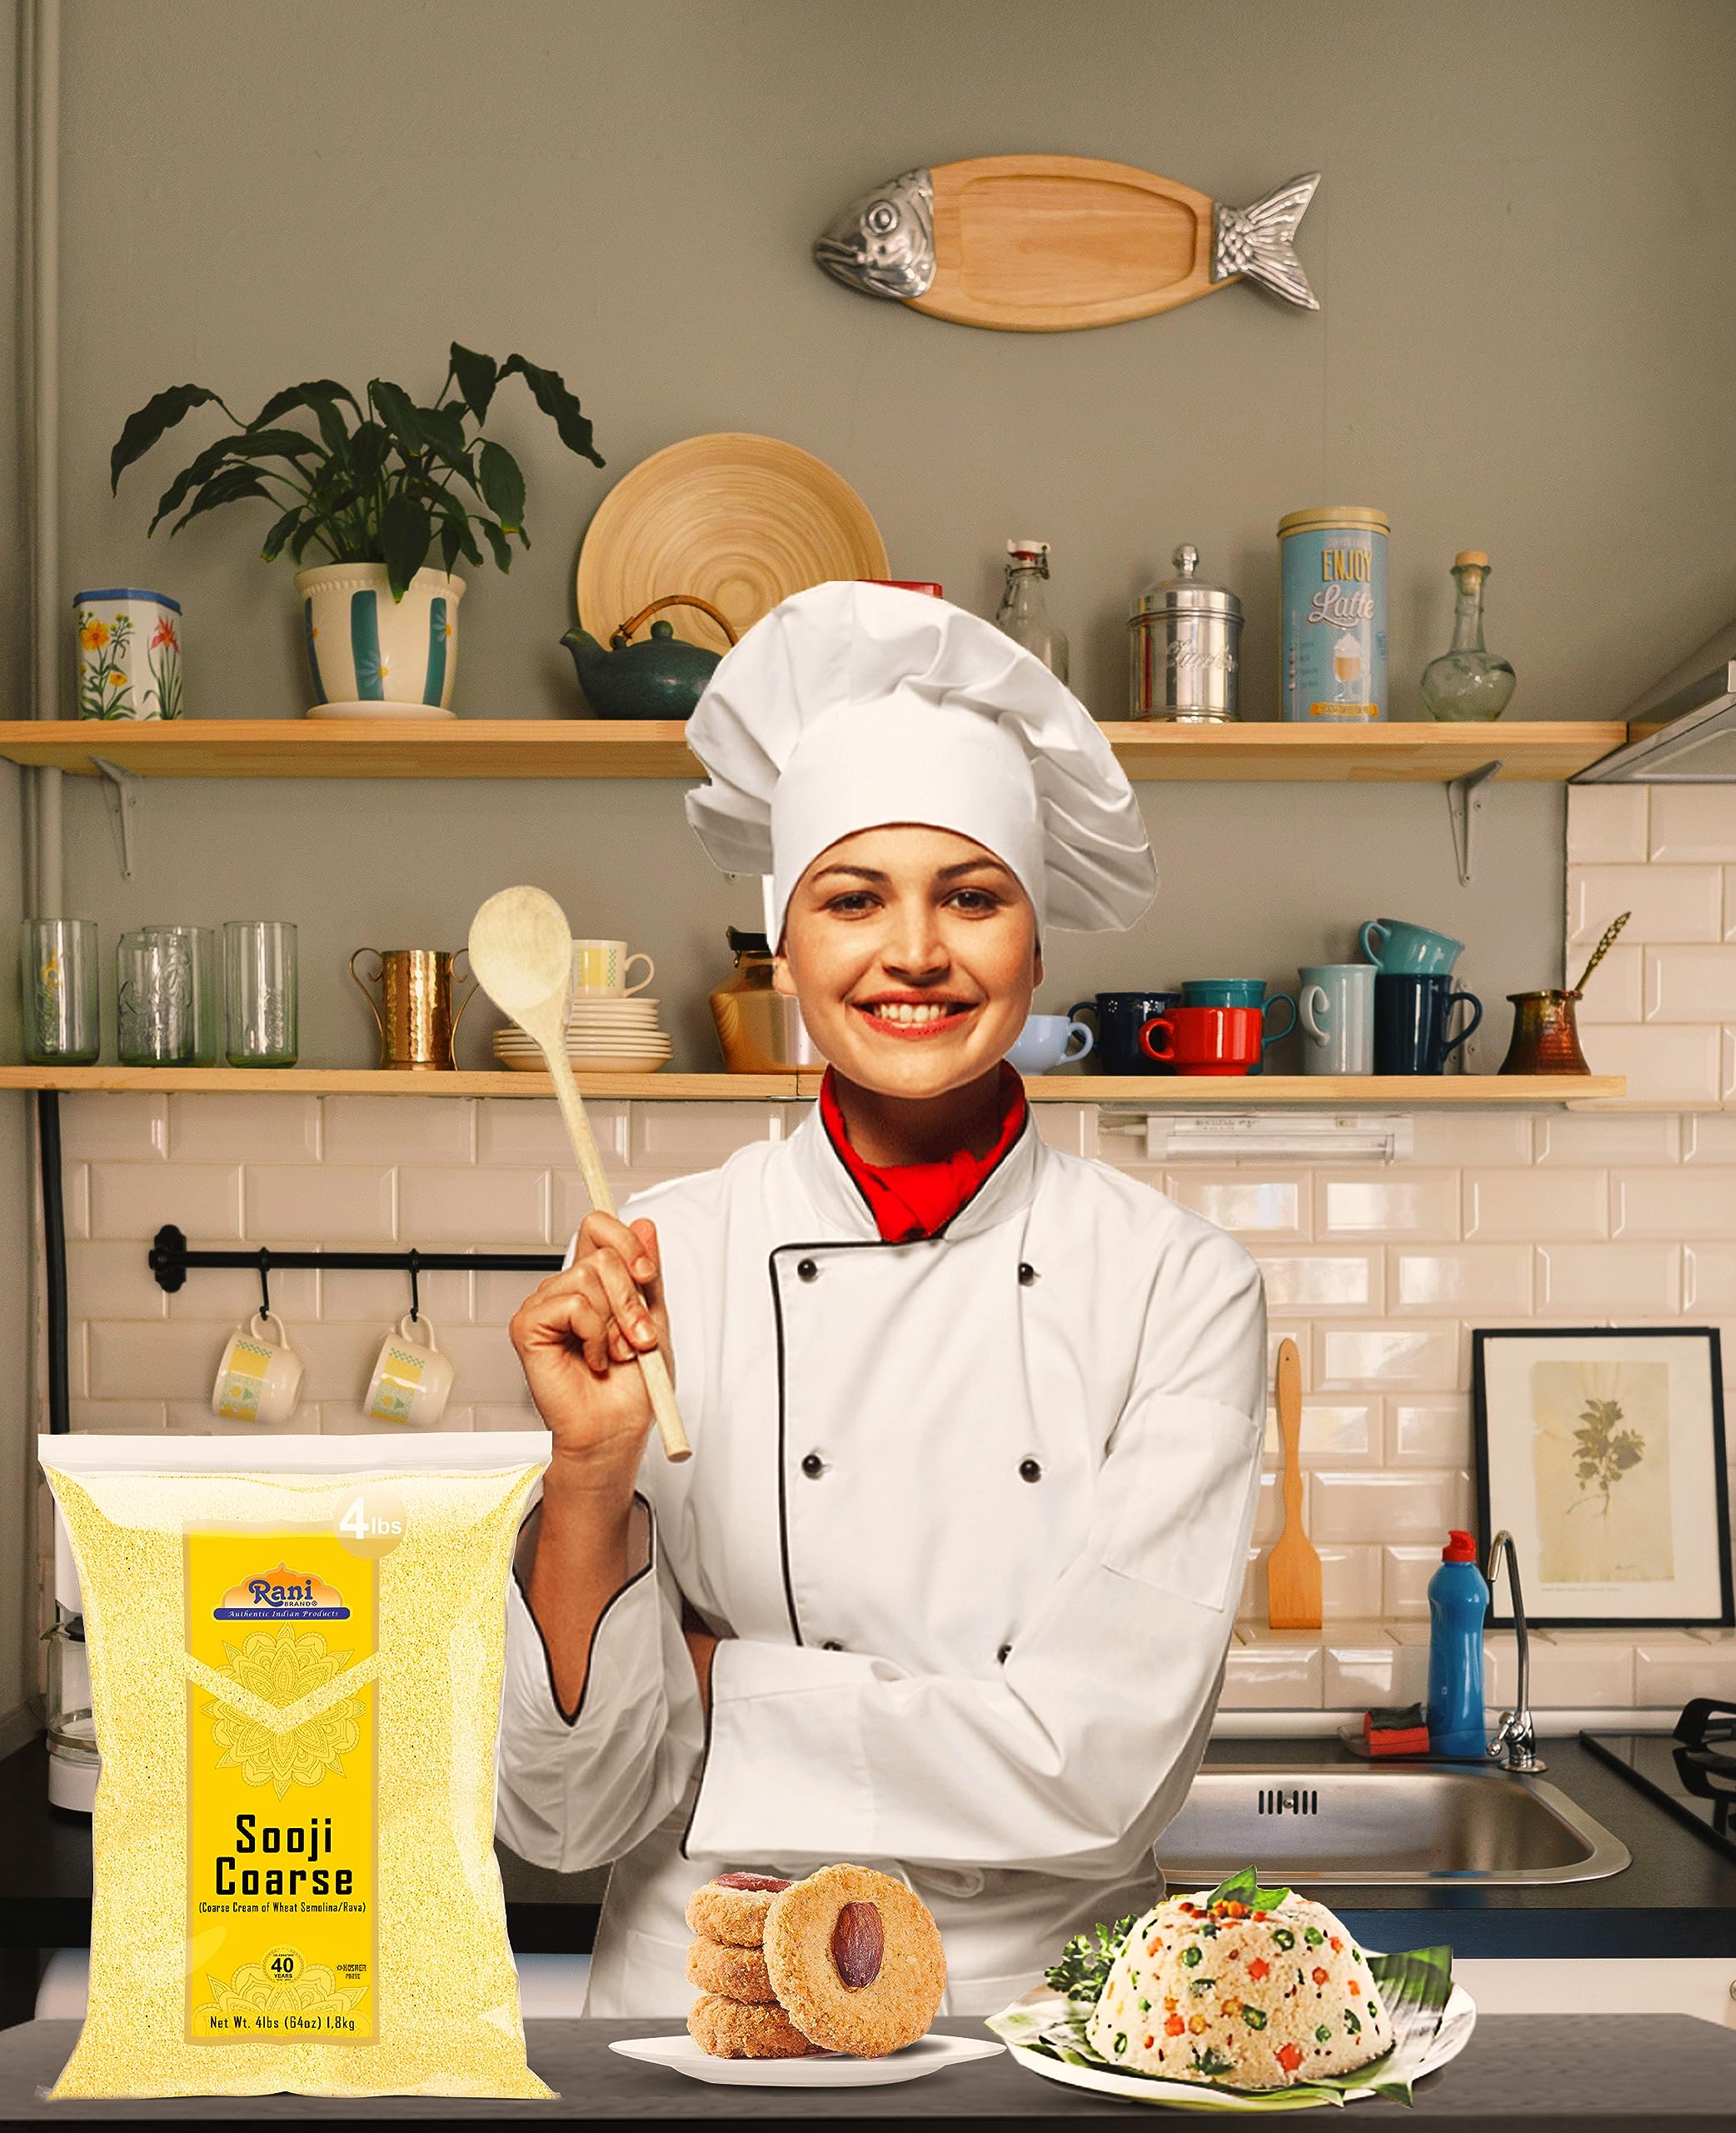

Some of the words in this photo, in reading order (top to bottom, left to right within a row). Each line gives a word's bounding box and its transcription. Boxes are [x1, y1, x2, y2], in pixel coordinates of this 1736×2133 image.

[1322, 548, 1374, 582] ENJOY
[1308, 584, 1374, 628] Latte
[339, 1496, 369, 1540] 4
[372, 1516, 402, 1535] lbs
[248, 1579, 314, 1607] Rani
[237, 1814, 332, 1861] Sooji
[217, 1856, 352, 1895] Coarse
[198, 1902, 230, 1912] (Coarse
[232, 1902, 259, 1912] Cream
[262, 1902, 270, 1912] of
[272, 1902, 297, 1912] Wheat
[301, 1902, 367, 1913] Semolina/Rava)
[271, 1957, 294, 1973] 40
[210, 2016, 228, 2028] Net
[234, 2016, 250, 2028] Wt.
[255, 2016, 279, 2028] 4lbs
[284, 2016, 322, 2031] (64oz)
